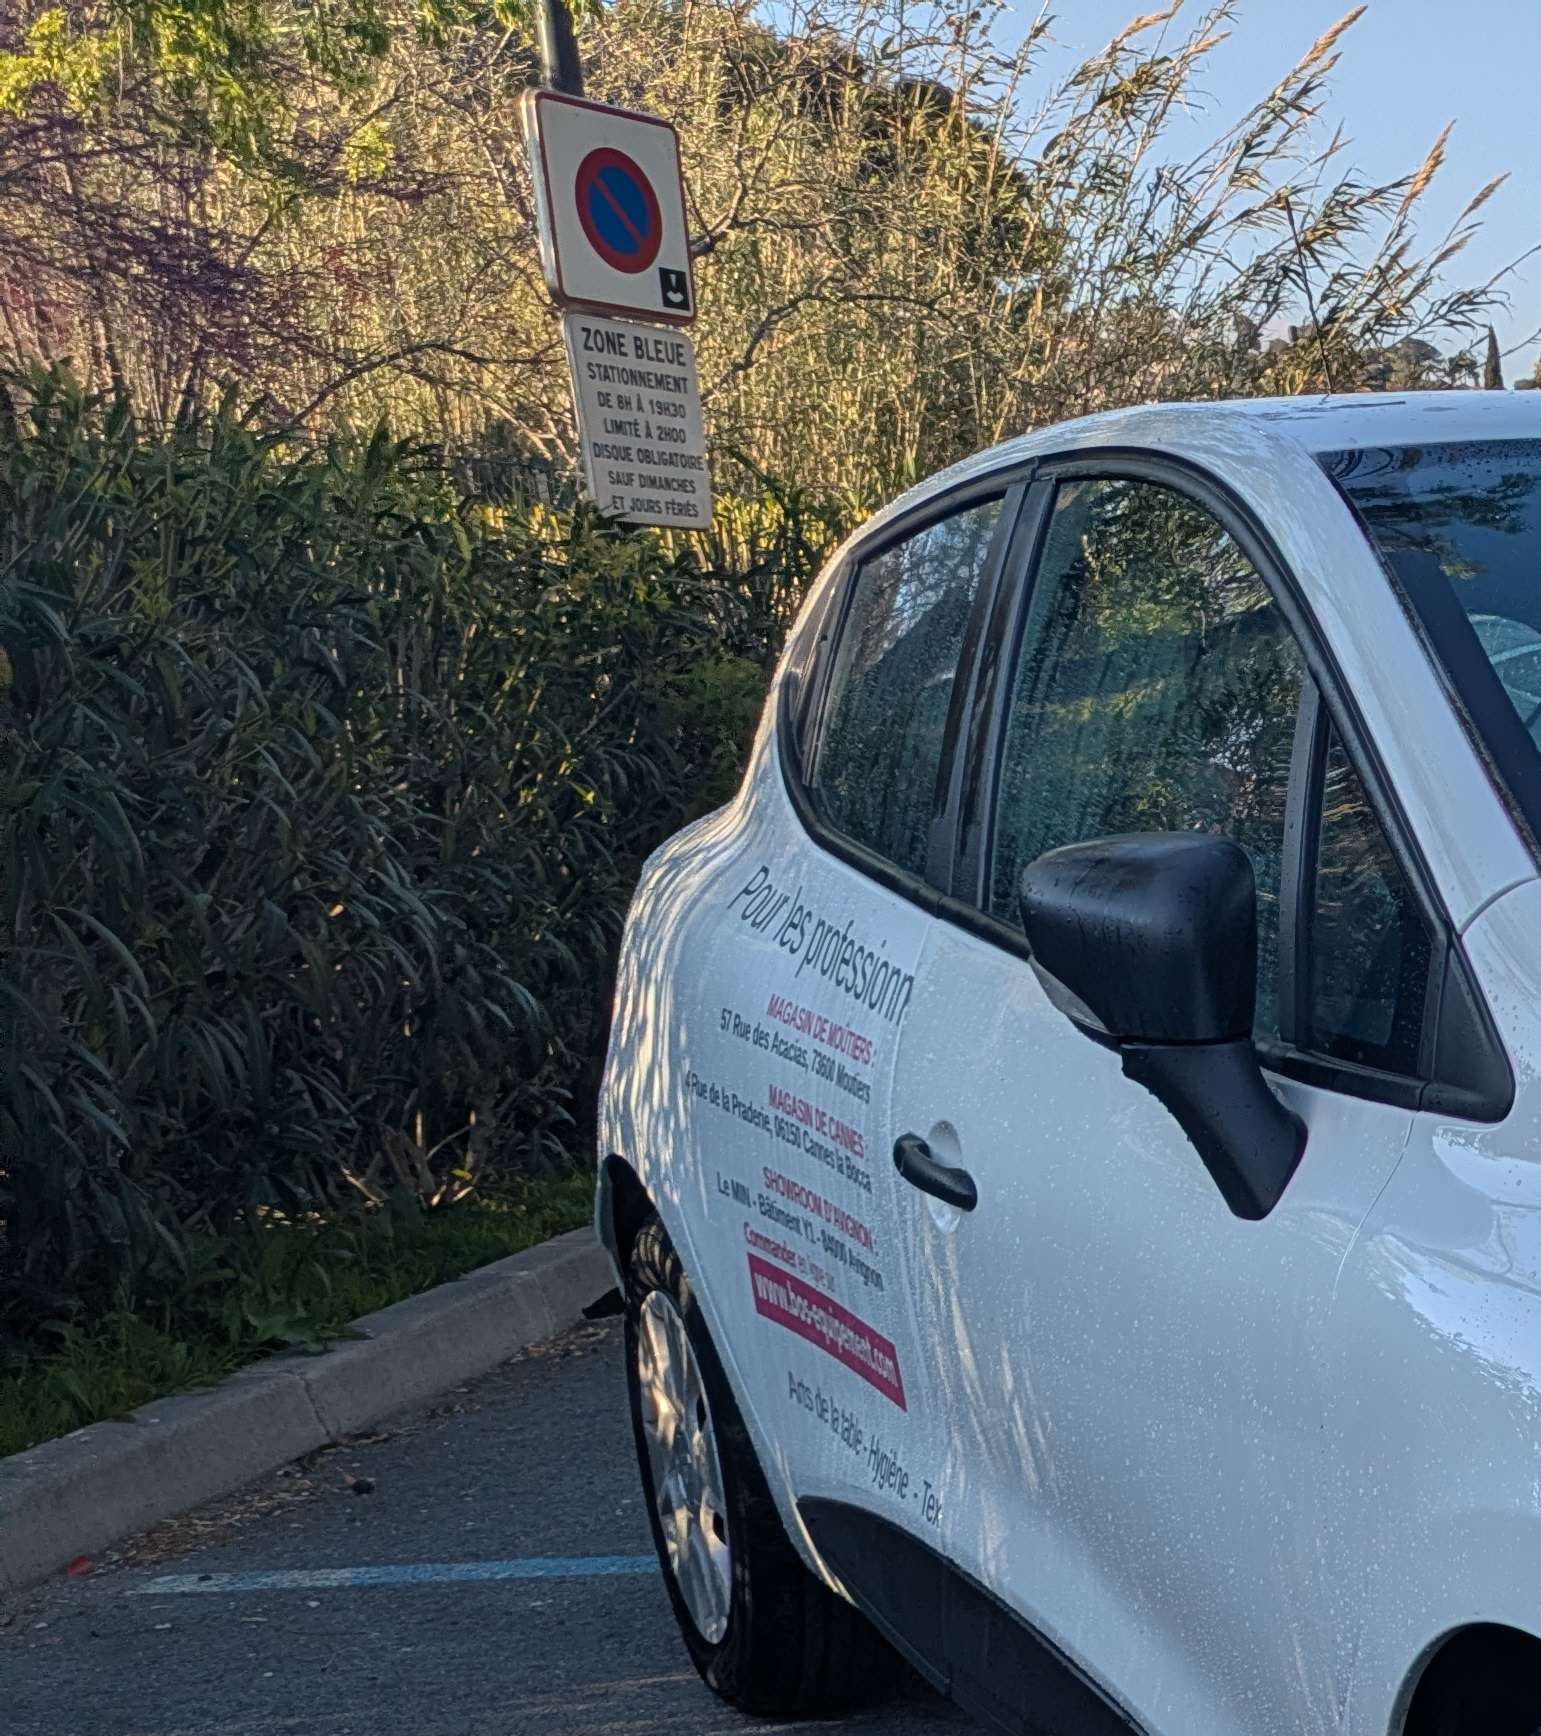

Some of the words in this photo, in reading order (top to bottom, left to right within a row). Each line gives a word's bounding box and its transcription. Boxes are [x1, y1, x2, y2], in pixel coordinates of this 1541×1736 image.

[581, 326, 628, 357] ZONE
[633, 335, 686, 367] BLEUE
[586, 362, 688, 394] STATIONNEMENT
[597, 391, 613, 408] DE
[636, 393, 644, 413] À
[649, 399, 686, 418] 19H30
[603, 418, 640, 438] LIMITÉ
[645, 420, 653, 439] À
[656, 425, 686, 443] 2H00
[592, 442, 633, 463] DISQUE
[637, 448, 704, 471] OBLIGATOIRE
[608, 470, 634, 486] SAUF
[638, 474, 696, 494] DIMANCHES
[612, 495, 624, 510] ET
[630, 497, 662, 514] JOURS
[727, 865, 790, 933] Pour
[772, 886, 812, 954] les
[720, 1007, 732, 1031] 57
[732, 1014, 752, 1042] Rue
[752, 1022, 769, 1050] des
[770, 1031, 809, 1074] Acacias,
[767, 993, 815, 1035] MAGASIN
[813, 1015, 829, 1043] DE
[691, 1072, 708, 1100] Rue
[709, 1082, 720, 1107] de
[721, 1086, 730, 1112] la
[731, 1093, 773, 1139] Praderie,
[803, 1130, 835, 1169] Cannes
[835, 1147, 845, 1175] la
[768, 1083, 813, 1128] MAGASIN
[815, 1107, 828, 1136] DE
[829, 1116, 864, 1159] CANNES
[716, 1170, 730, 1197] Le
[763, 1166, 824, 1219] SHOWROOM
[754, 1272, 899, 1388] www.bos-equipement.com
[788, 1370, 814, 1412] Arts
[815, 1385, 829, 1424] de
[830, 1396, 840, 1434] la
[841, 1408, 863, 1456] table
[867, 1434, 909, 1499] Hygiène
